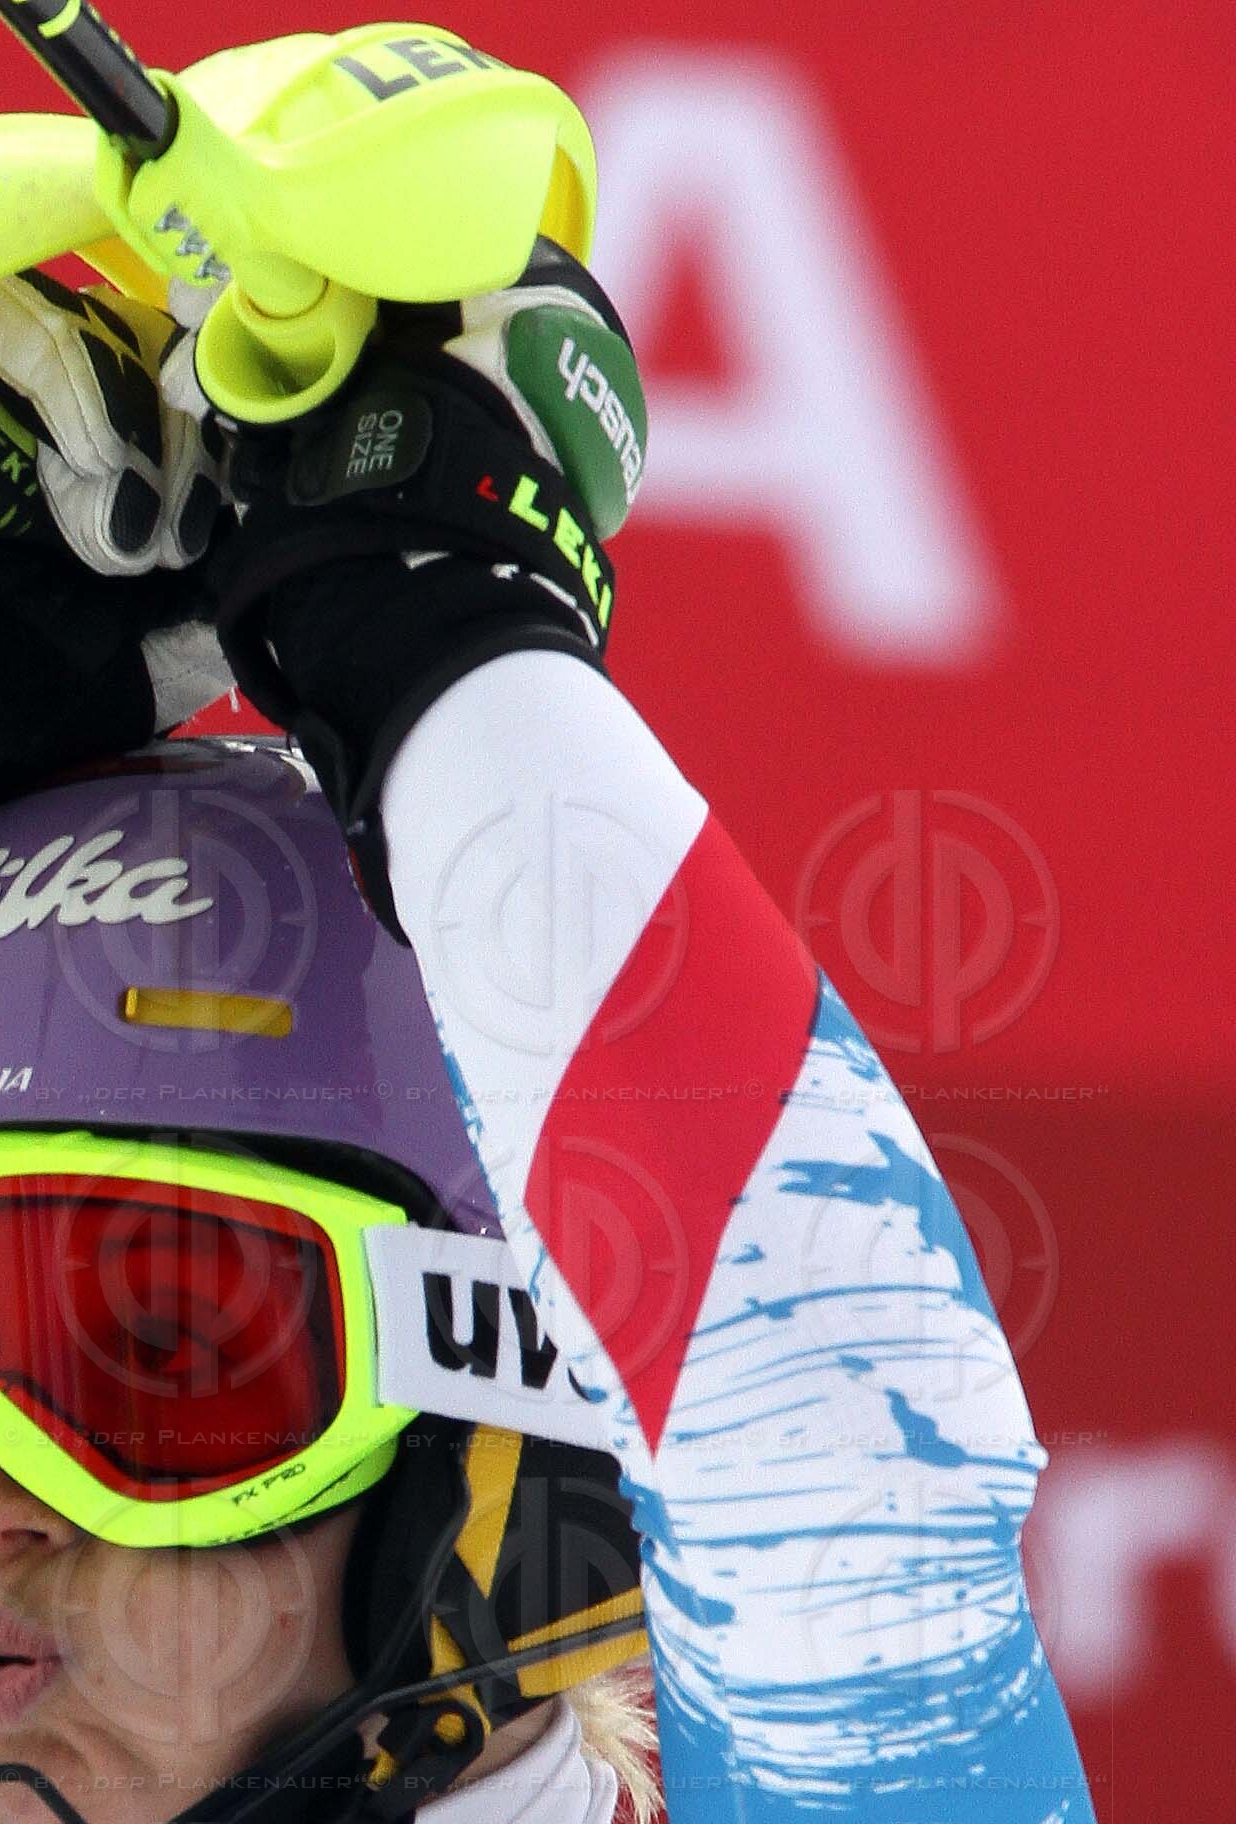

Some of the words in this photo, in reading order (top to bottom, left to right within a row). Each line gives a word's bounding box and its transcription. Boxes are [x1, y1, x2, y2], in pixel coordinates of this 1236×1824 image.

[346, 412, 378, 478] SIZE
[369, 409, 403, 470] ONE
[508, 474, 613, 629] LEKI
[421, 1271, 596, 1402] uv
